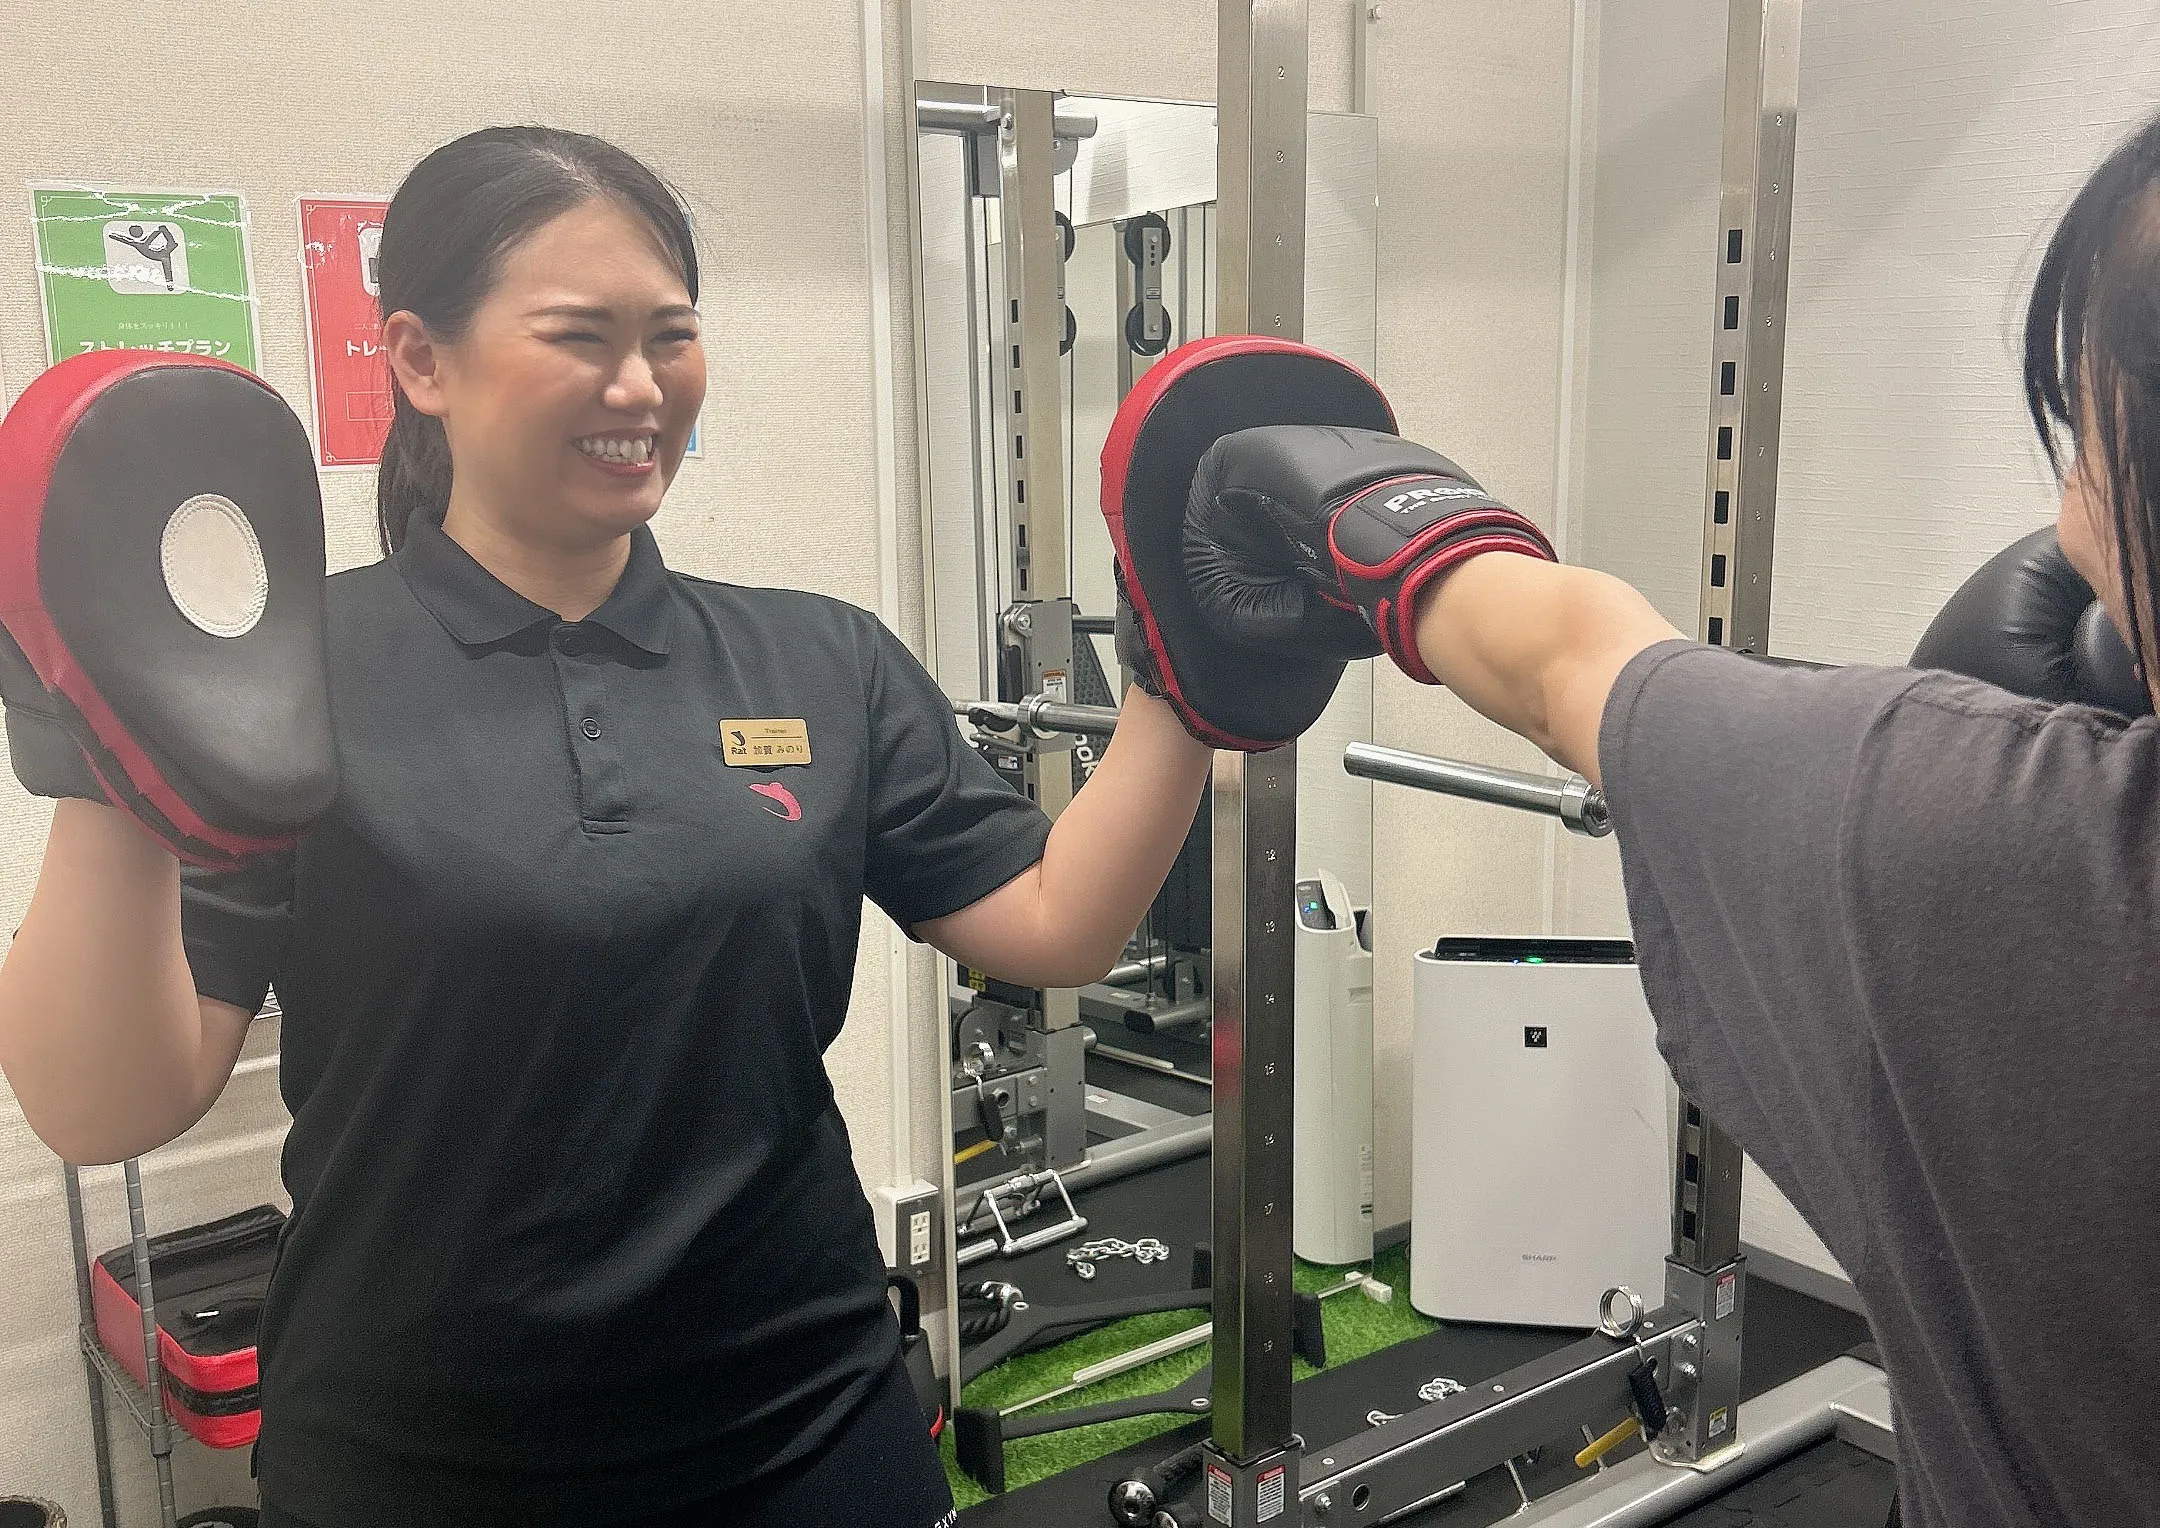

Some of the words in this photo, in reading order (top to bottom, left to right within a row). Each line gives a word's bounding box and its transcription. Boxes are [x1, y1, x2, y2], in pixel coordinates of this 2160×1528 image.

[1277, 65, 1285, 80] 2
[1276, 151, 1285, 163] 3
[1275, 234, 1282, 246] 4
[1758, 446, 1765, 457] 7
